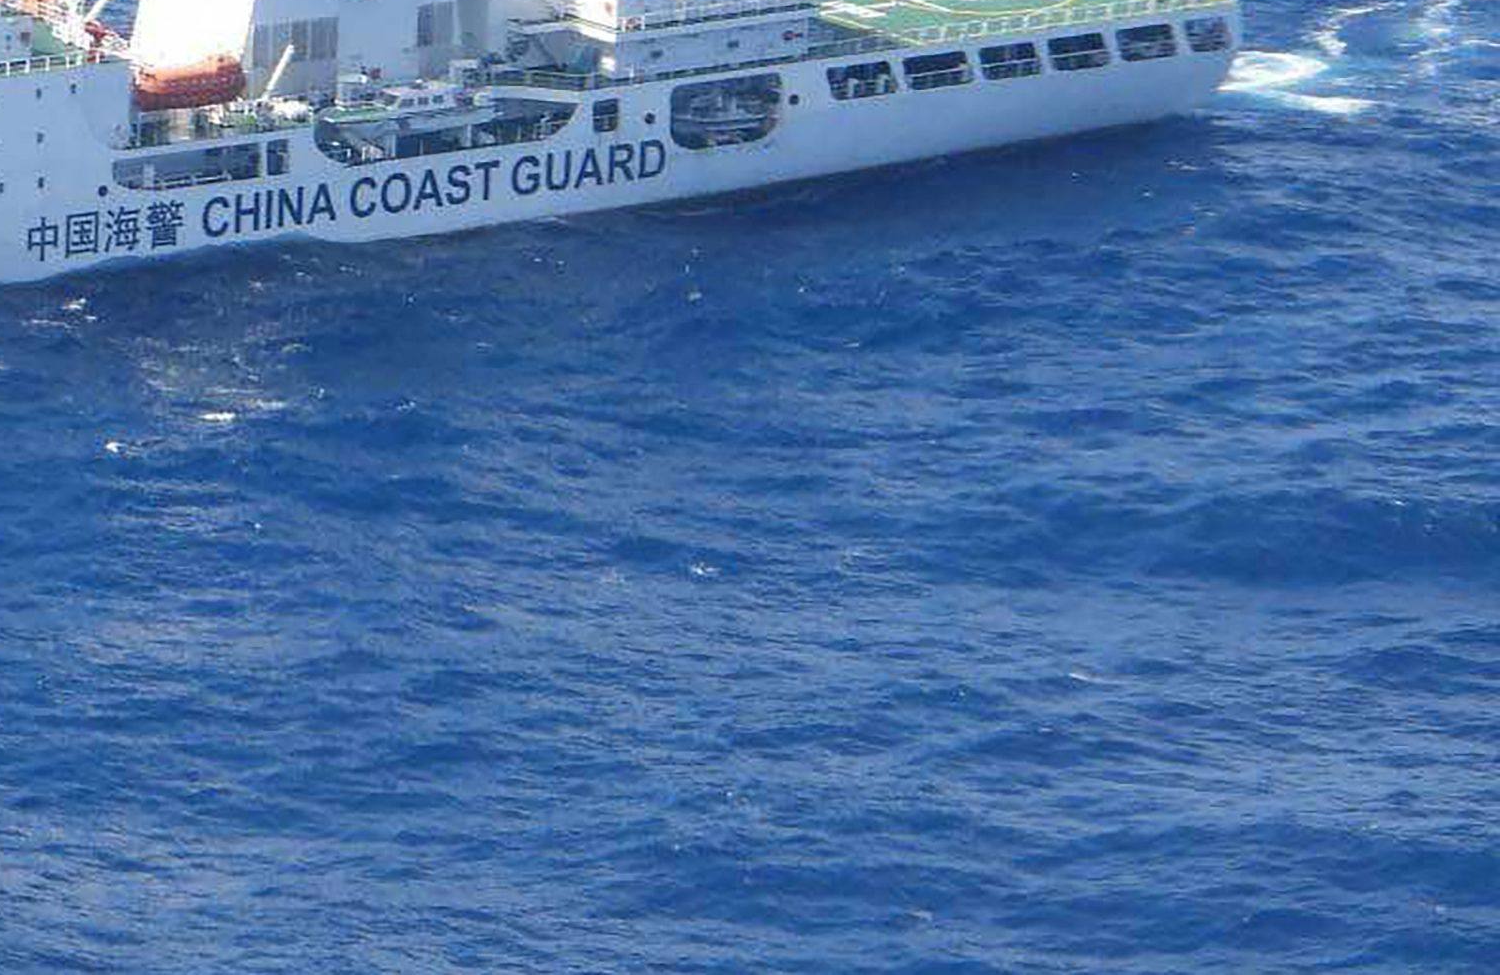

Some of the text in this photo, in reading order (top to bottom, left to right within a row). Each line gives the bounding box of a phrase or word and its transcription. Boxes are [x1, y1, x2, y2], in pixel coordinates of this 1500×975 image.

[26, 139, 667, 262] 中国海警 CHINA COAST GUARD
